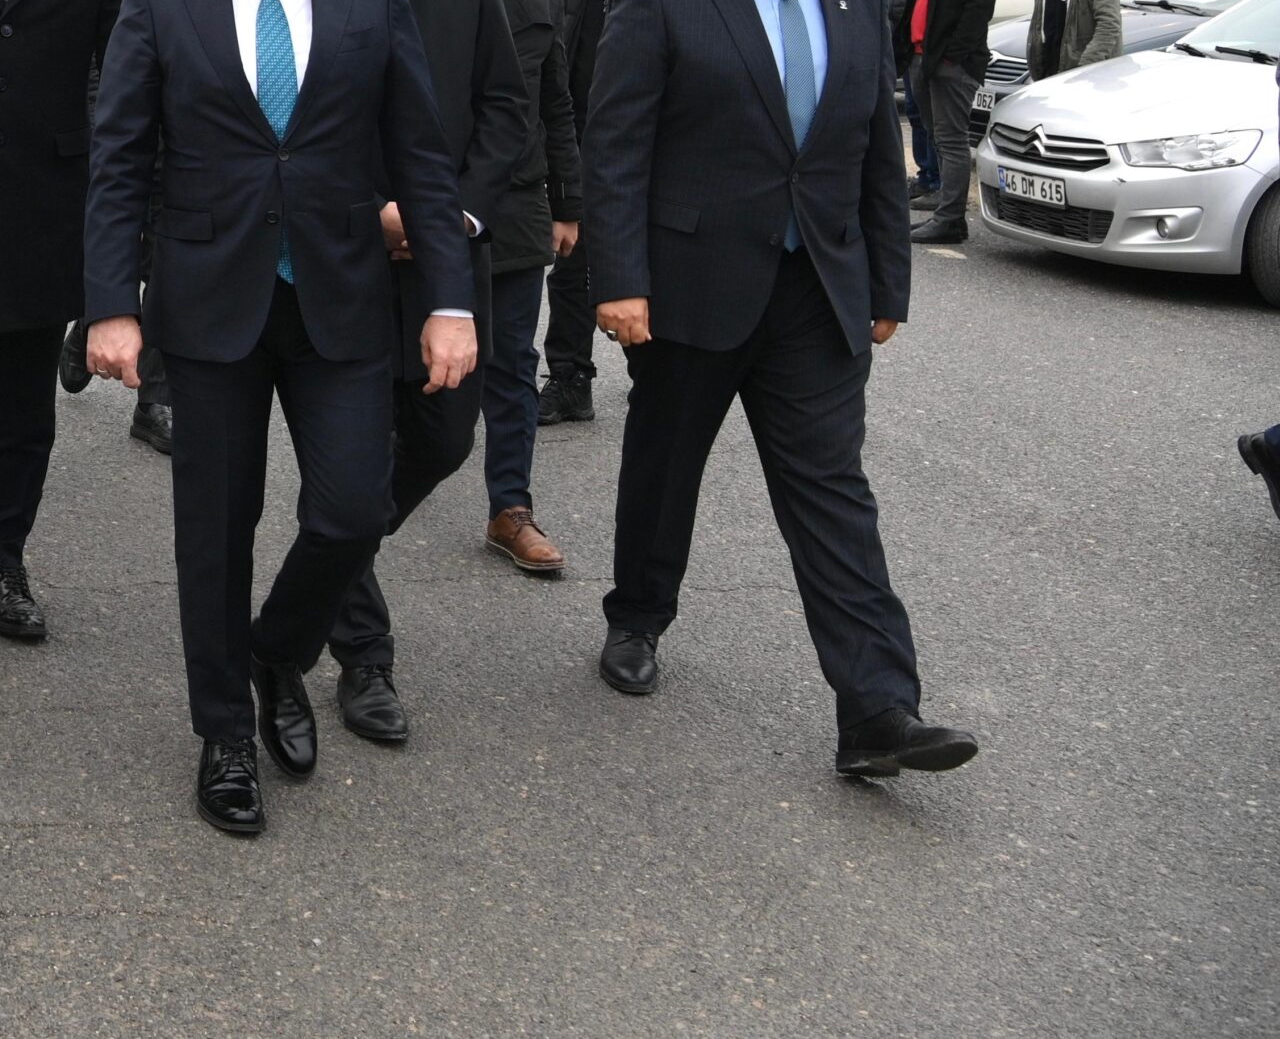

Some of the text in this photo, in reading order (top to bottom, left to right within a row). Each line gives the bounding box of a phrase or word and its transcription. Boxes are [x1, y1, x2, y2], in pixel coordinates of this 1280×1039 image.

[1005, 172, 1064, 203] 46 DM 615
